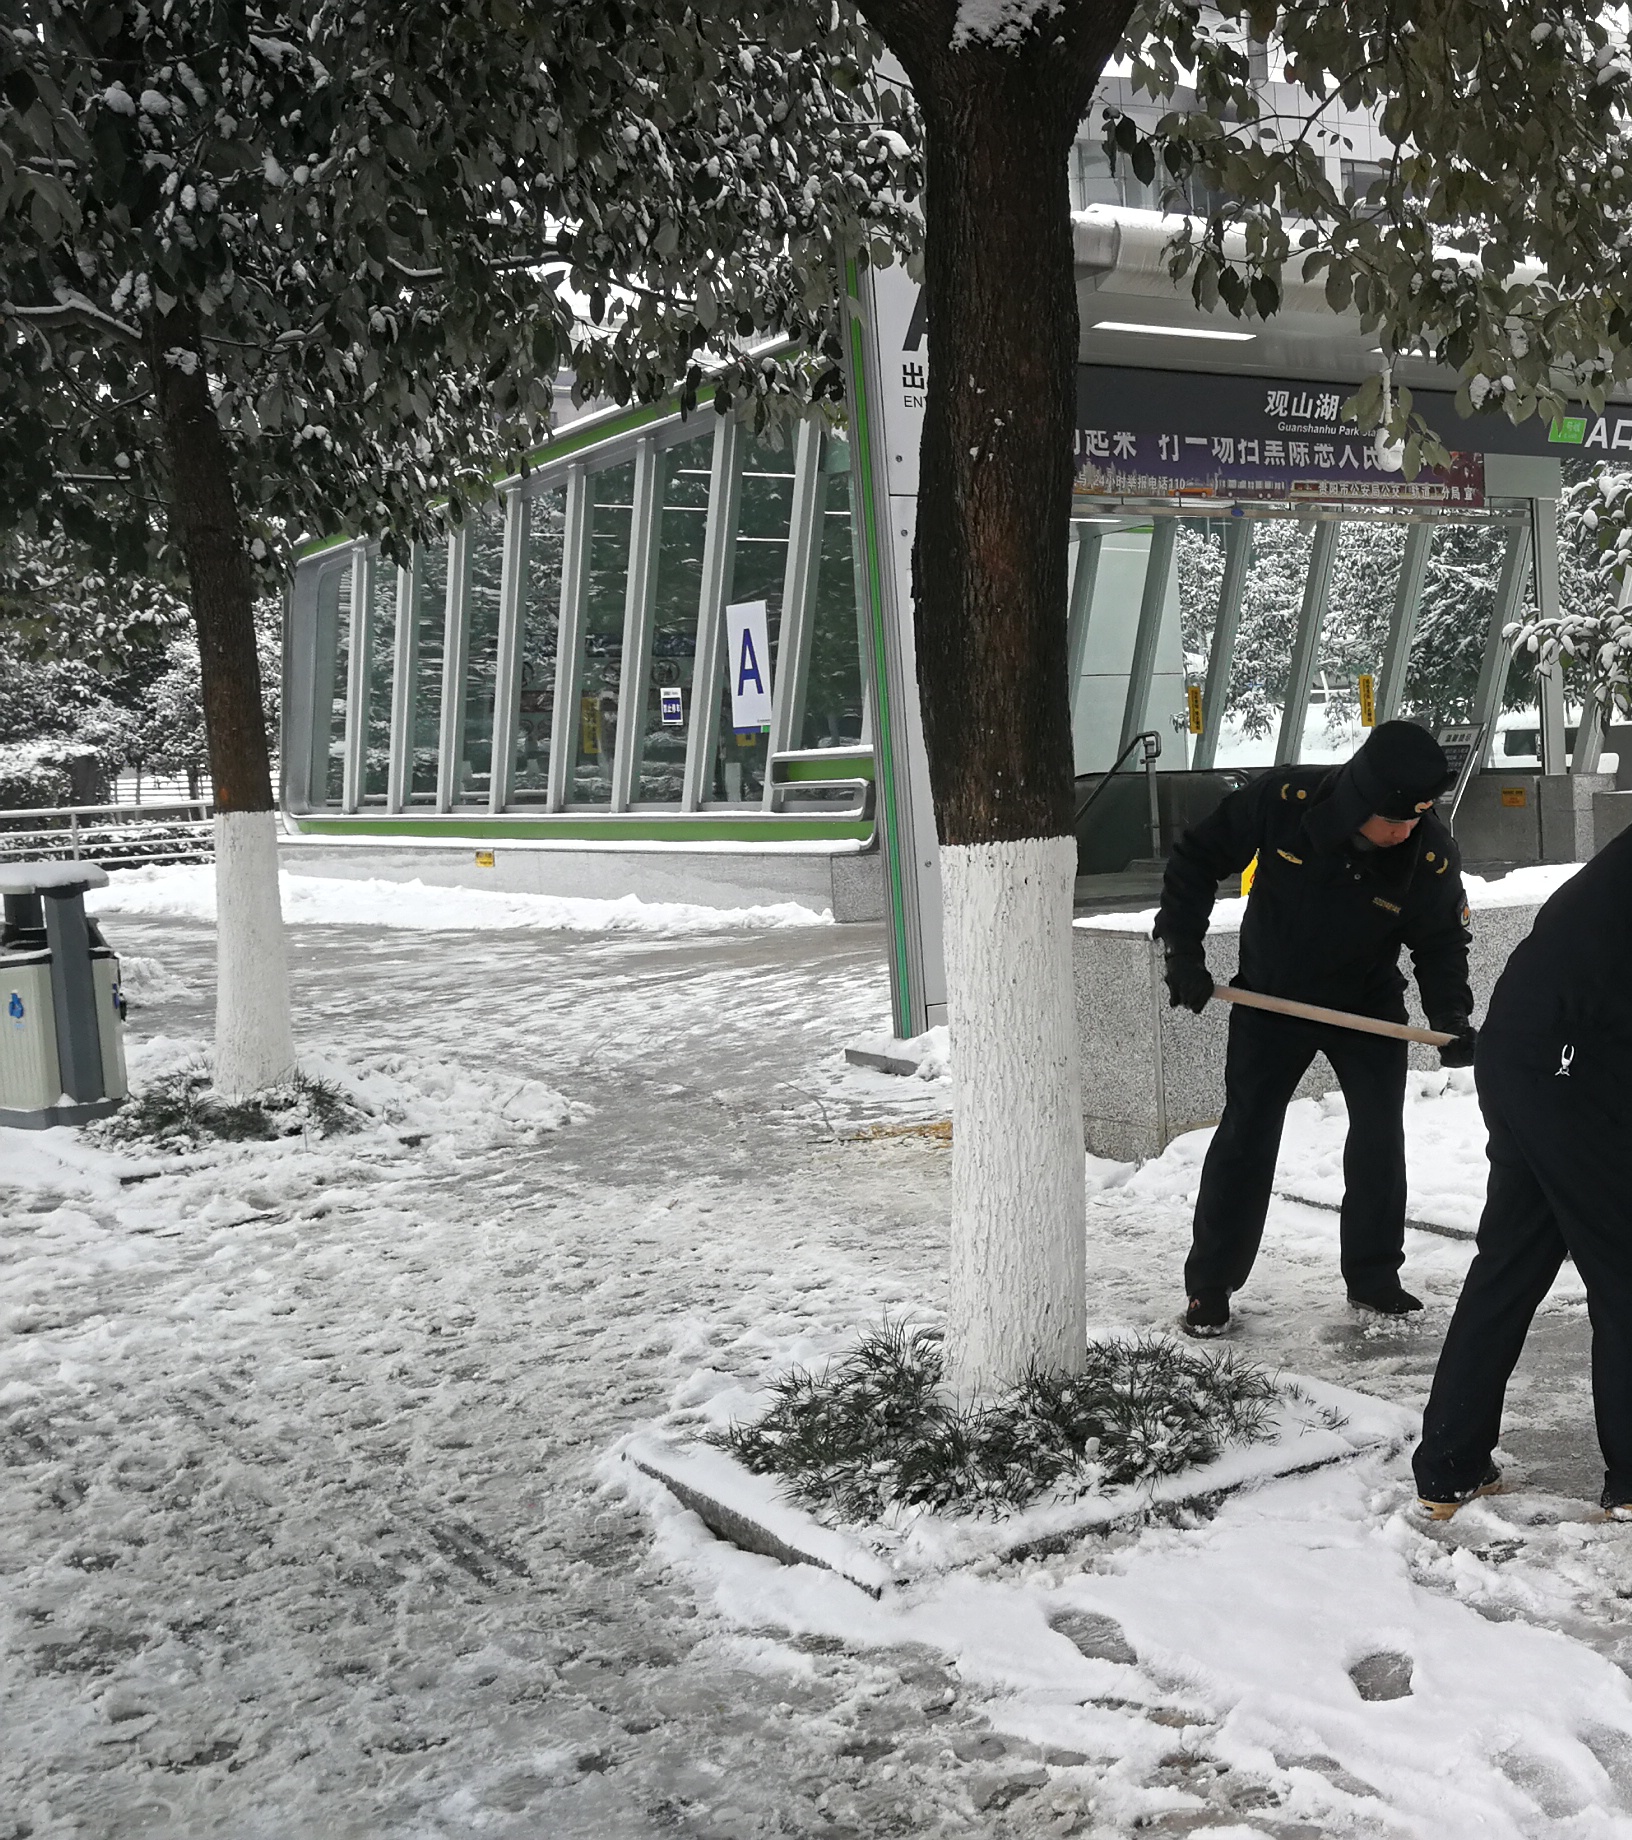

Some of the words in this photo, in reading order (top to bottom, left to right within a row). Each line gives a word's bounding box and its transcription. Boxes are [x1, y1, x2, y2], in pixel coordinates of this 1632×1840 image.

[1264, 390, 1386, 423] 观山湖
[1277, 421, 1337, 435] Guanshanhu
[1338, 424, 1360, 437] Park
[737, 627, 764, 696] A
